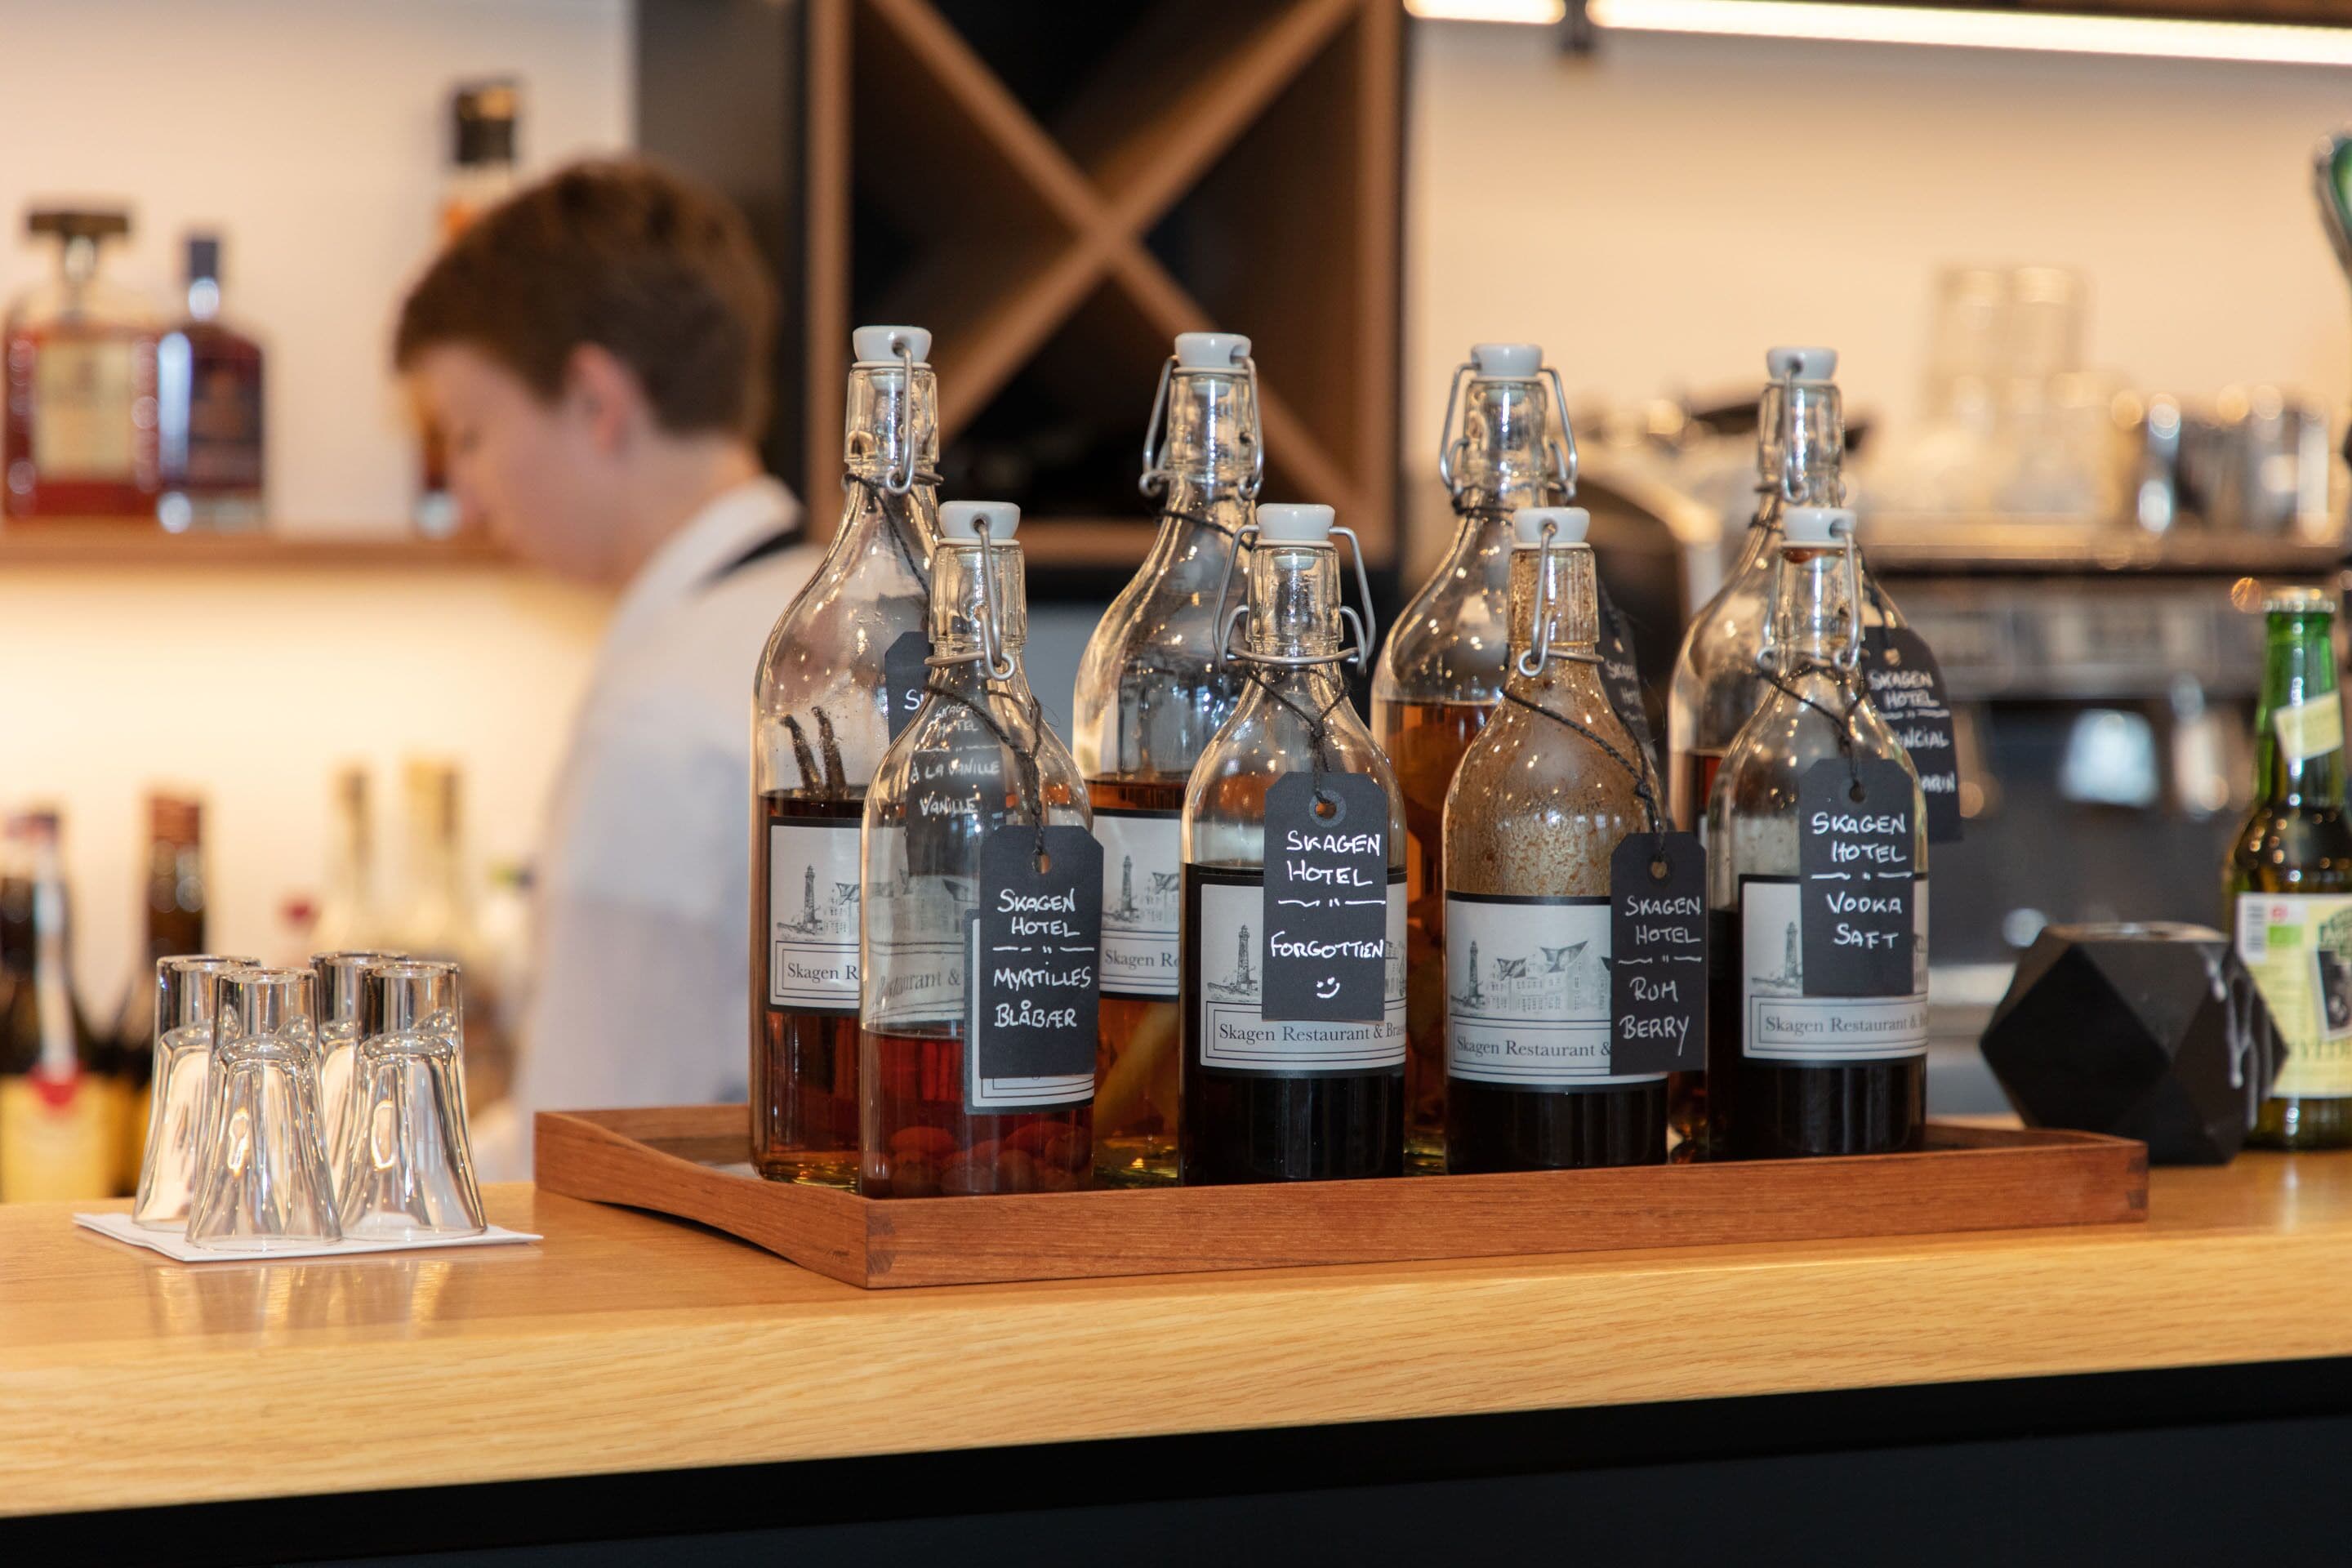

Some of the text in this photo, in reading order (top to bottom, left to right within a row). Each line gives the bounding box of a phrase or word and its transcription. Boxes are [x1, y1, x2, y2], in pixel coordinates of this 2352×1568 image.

[1868, 670, 1935, 691] SKAGEN
[1884, 689, 1940, 709] HOTEL
[924, 764, 944, 778] LA
[1922, 771, 1955, 794] ARIN
[919, 789, 979, 816] VANILLE
[1811, 811, 1907, 835] SKAGEN
[1287, 830, 1381, 856] SKAGEN
[1831, 840, 1908, 863] HOTEL
[1287, 859, 1373, 886] HOTEL
[997, 888, 1076, 912] SKAGEN
[1625, 895, 1701, 916] SKAGEN
[1826, 890, 1903, 914] VODKA
[1011, 916, 1080, 937] HOTEL
[1636, 924, 1701, 945] HOTEL
[1833, 923, 1900, 949] SAFT
[1105, 948, 1155, 971] Skagen
[786, 962, 839, 983] Skagen
[993, 960, 1092, 991] MYRTILLES
[1629, 977, 1679, 1003] RUM
[994, 1000, 1077, 1029] BLÅBÆR
[1766, 1016, 1824, 1036] Skagen
[1830, 1017, 1907, 1033] Restaurant
[1219, 1023, 1275, 1045] Skagen
[1282, 1025, 1370, 1042] Restaurant
[1374, 1024, 1383, 1039] &
[1619, 1014, 1690, 1057] BERRY
[1457, 1035, 1612, 1058] Skagen Restaurant &
